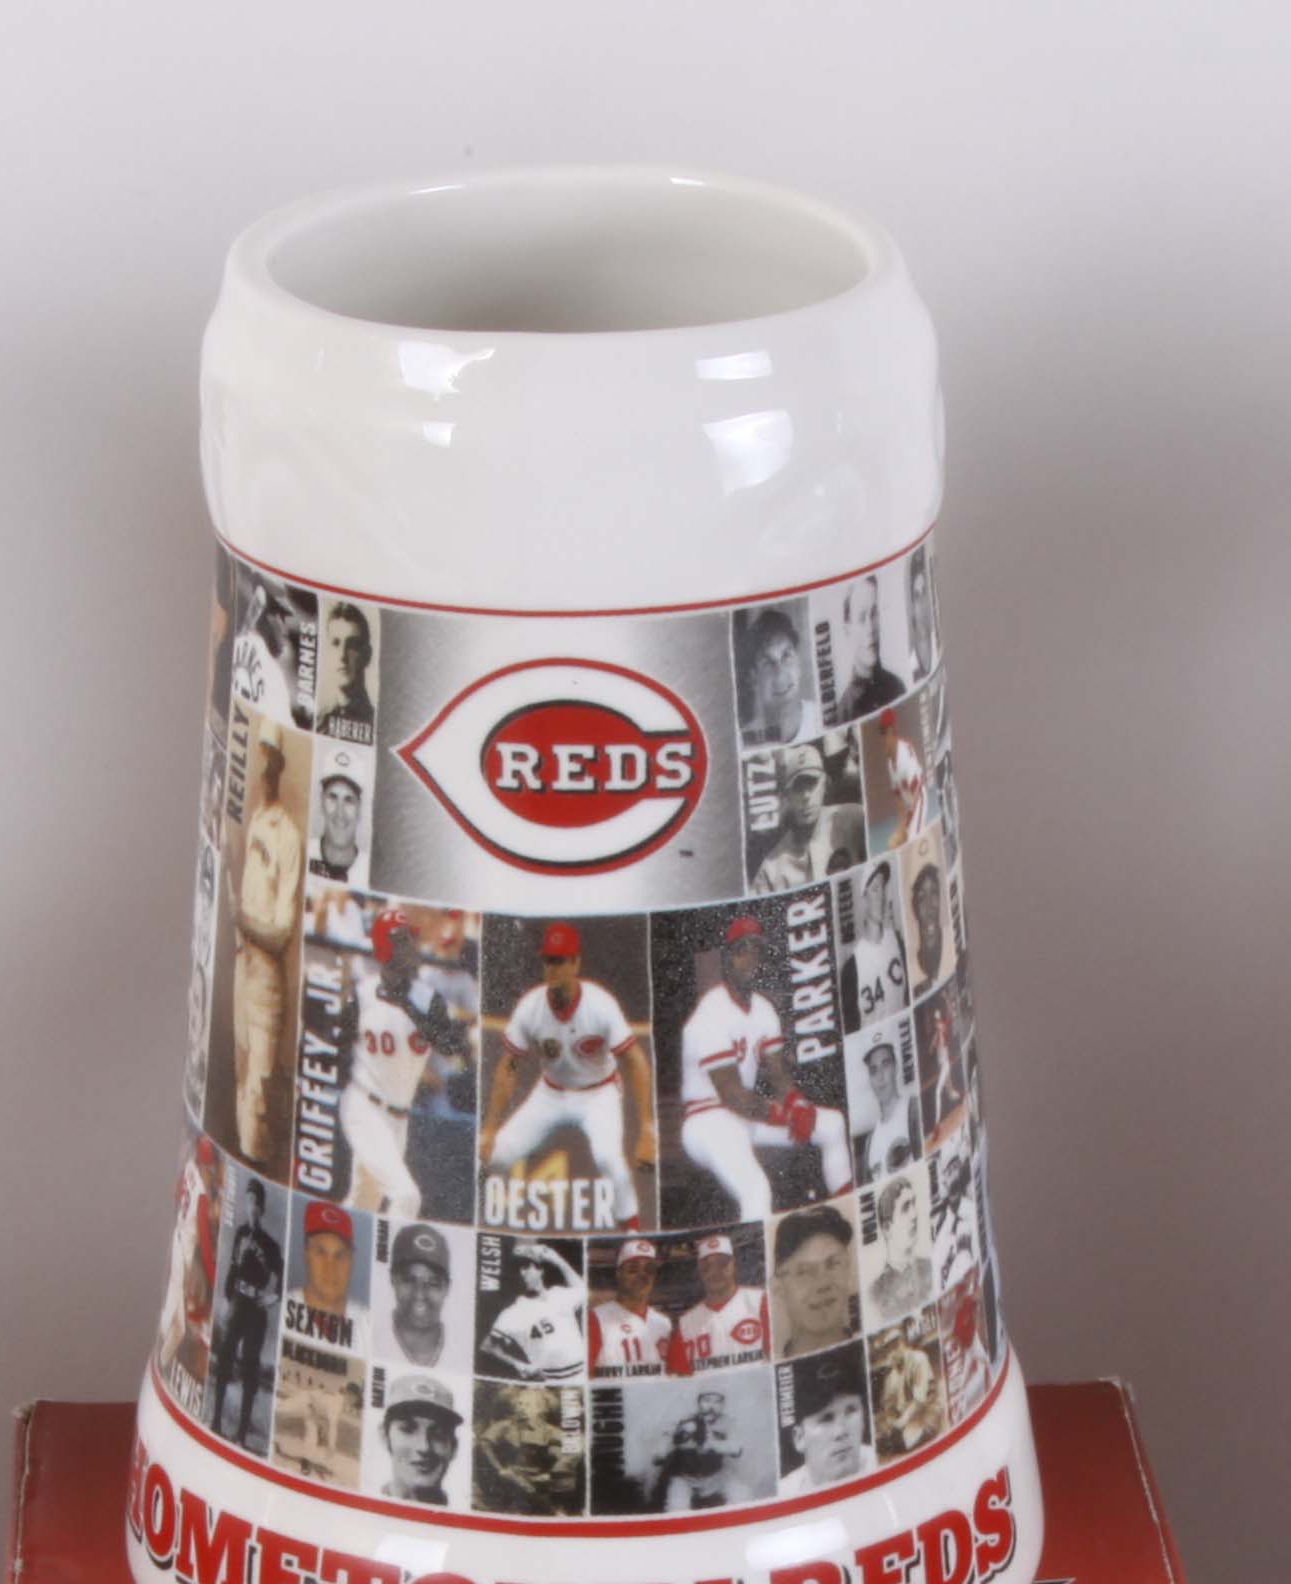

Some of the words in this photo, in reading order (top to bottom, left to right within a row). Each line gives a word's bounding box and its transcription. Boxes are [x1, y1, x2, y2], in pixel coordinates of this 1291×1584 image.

[226, 703, 250, 824] REILLY
[494, 740, 696, 794] REDS
[746, 757, 781, 833] LUTZ
[786, 893, 840, 1065] PARKER
[365, 1030, 397, 1057] 30
[484, 1174, 617, 1231] OESTER
[476, 1235, 502, 1292] WELSH
[284, 1299, 354, 1349] SEXTON
[529, 1321, 555, 1340] 45
